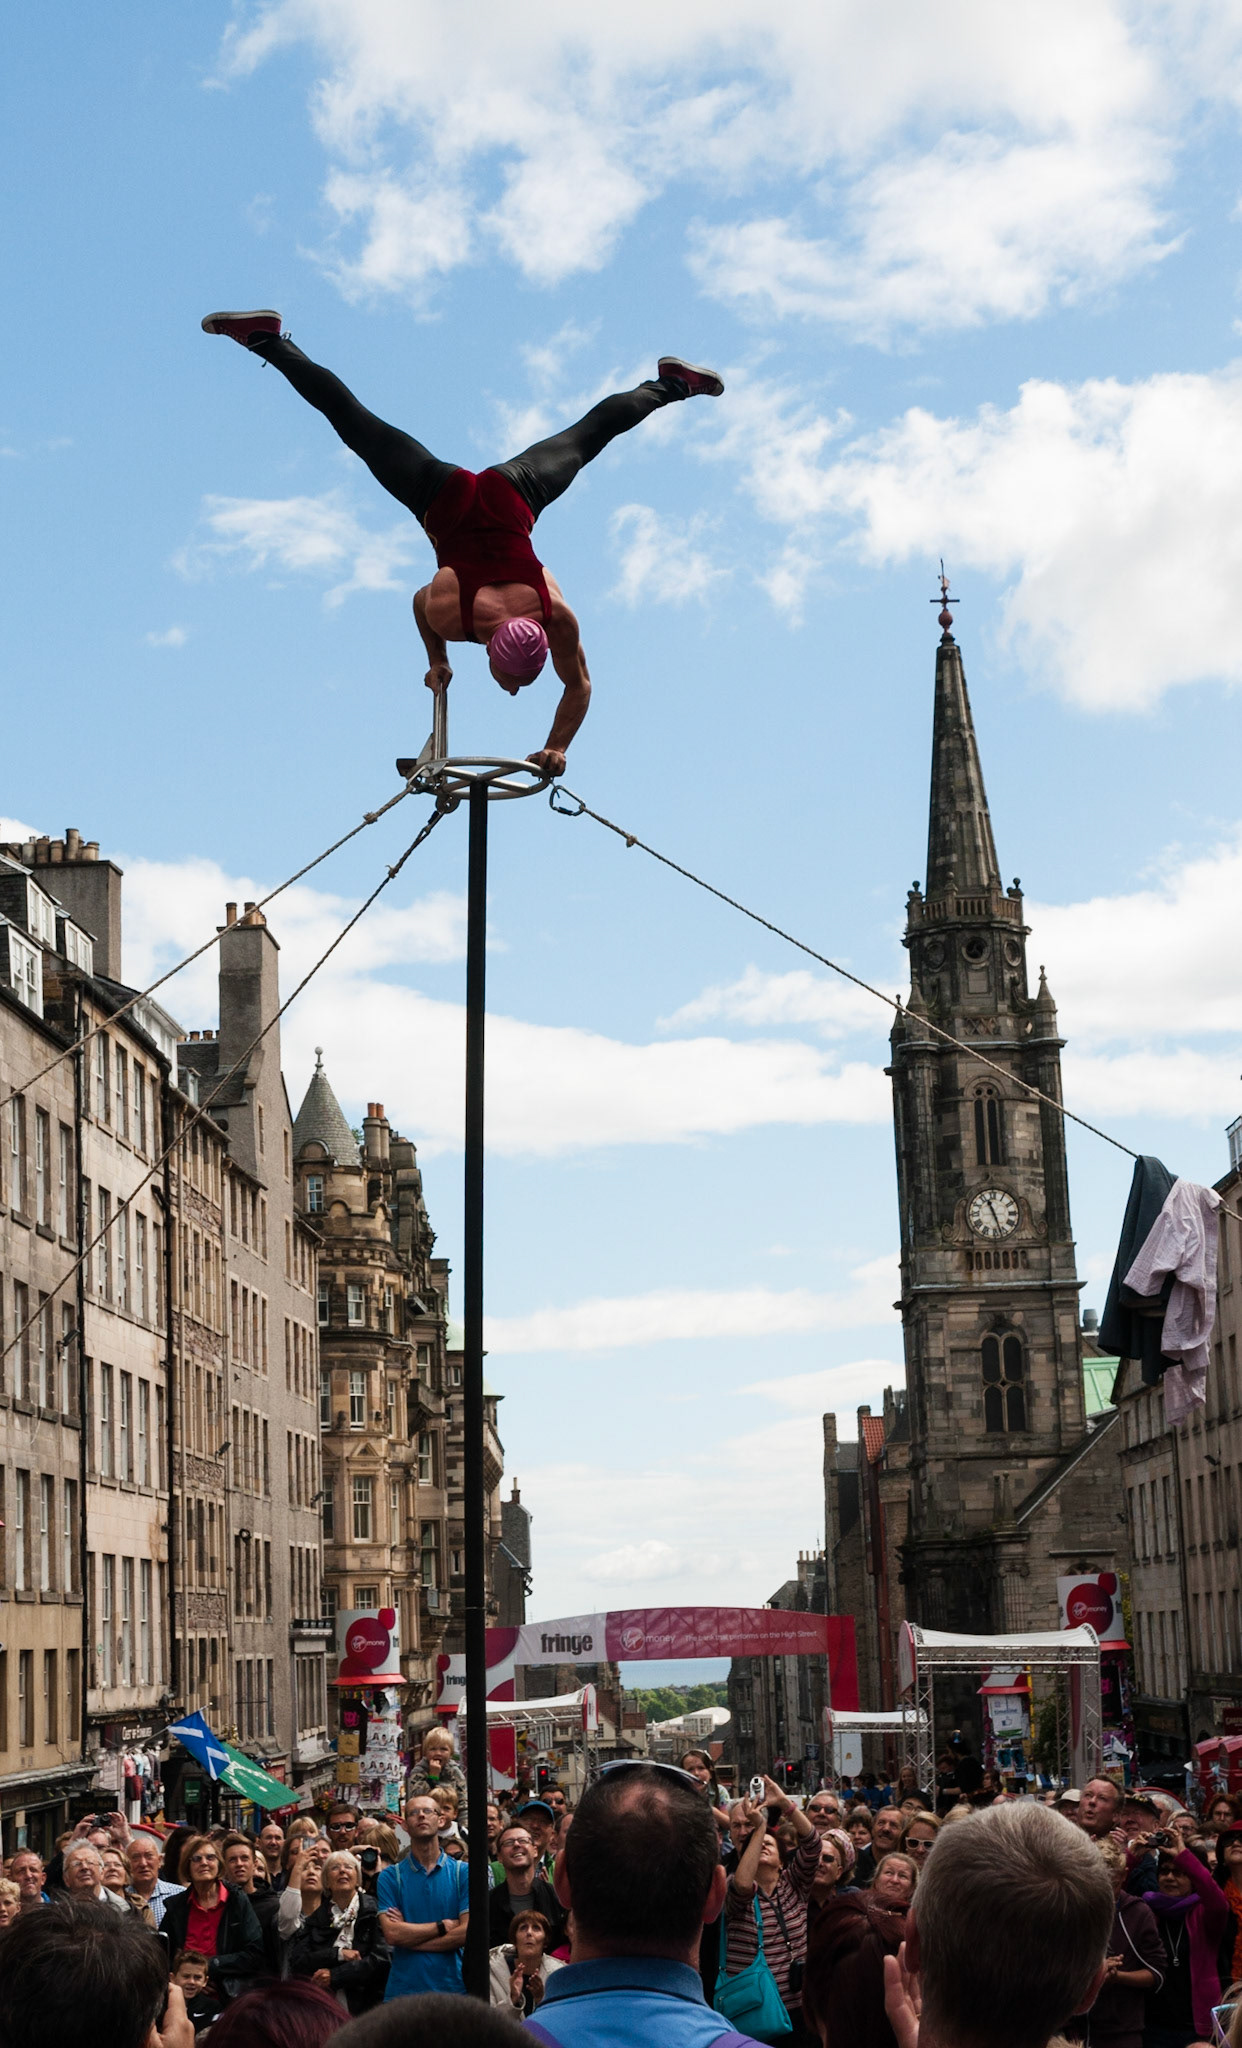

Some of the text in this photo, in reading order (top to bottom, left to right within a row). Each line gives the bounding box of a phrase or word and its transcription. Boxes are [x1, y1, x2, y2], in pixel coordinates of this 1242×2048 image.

[645, 1634, 676, 1643] money
[685, 1634, 697, 1642] The
[715, 1633, 728, 1641] that
[729, 1633, 759, 1641] performs
[781, 1631, 796, 1639] High
[366, 1639, 386, 1647] money
[541, 1633, 593, 1655] fringe
[446, 1675, 466, 1686] fring
